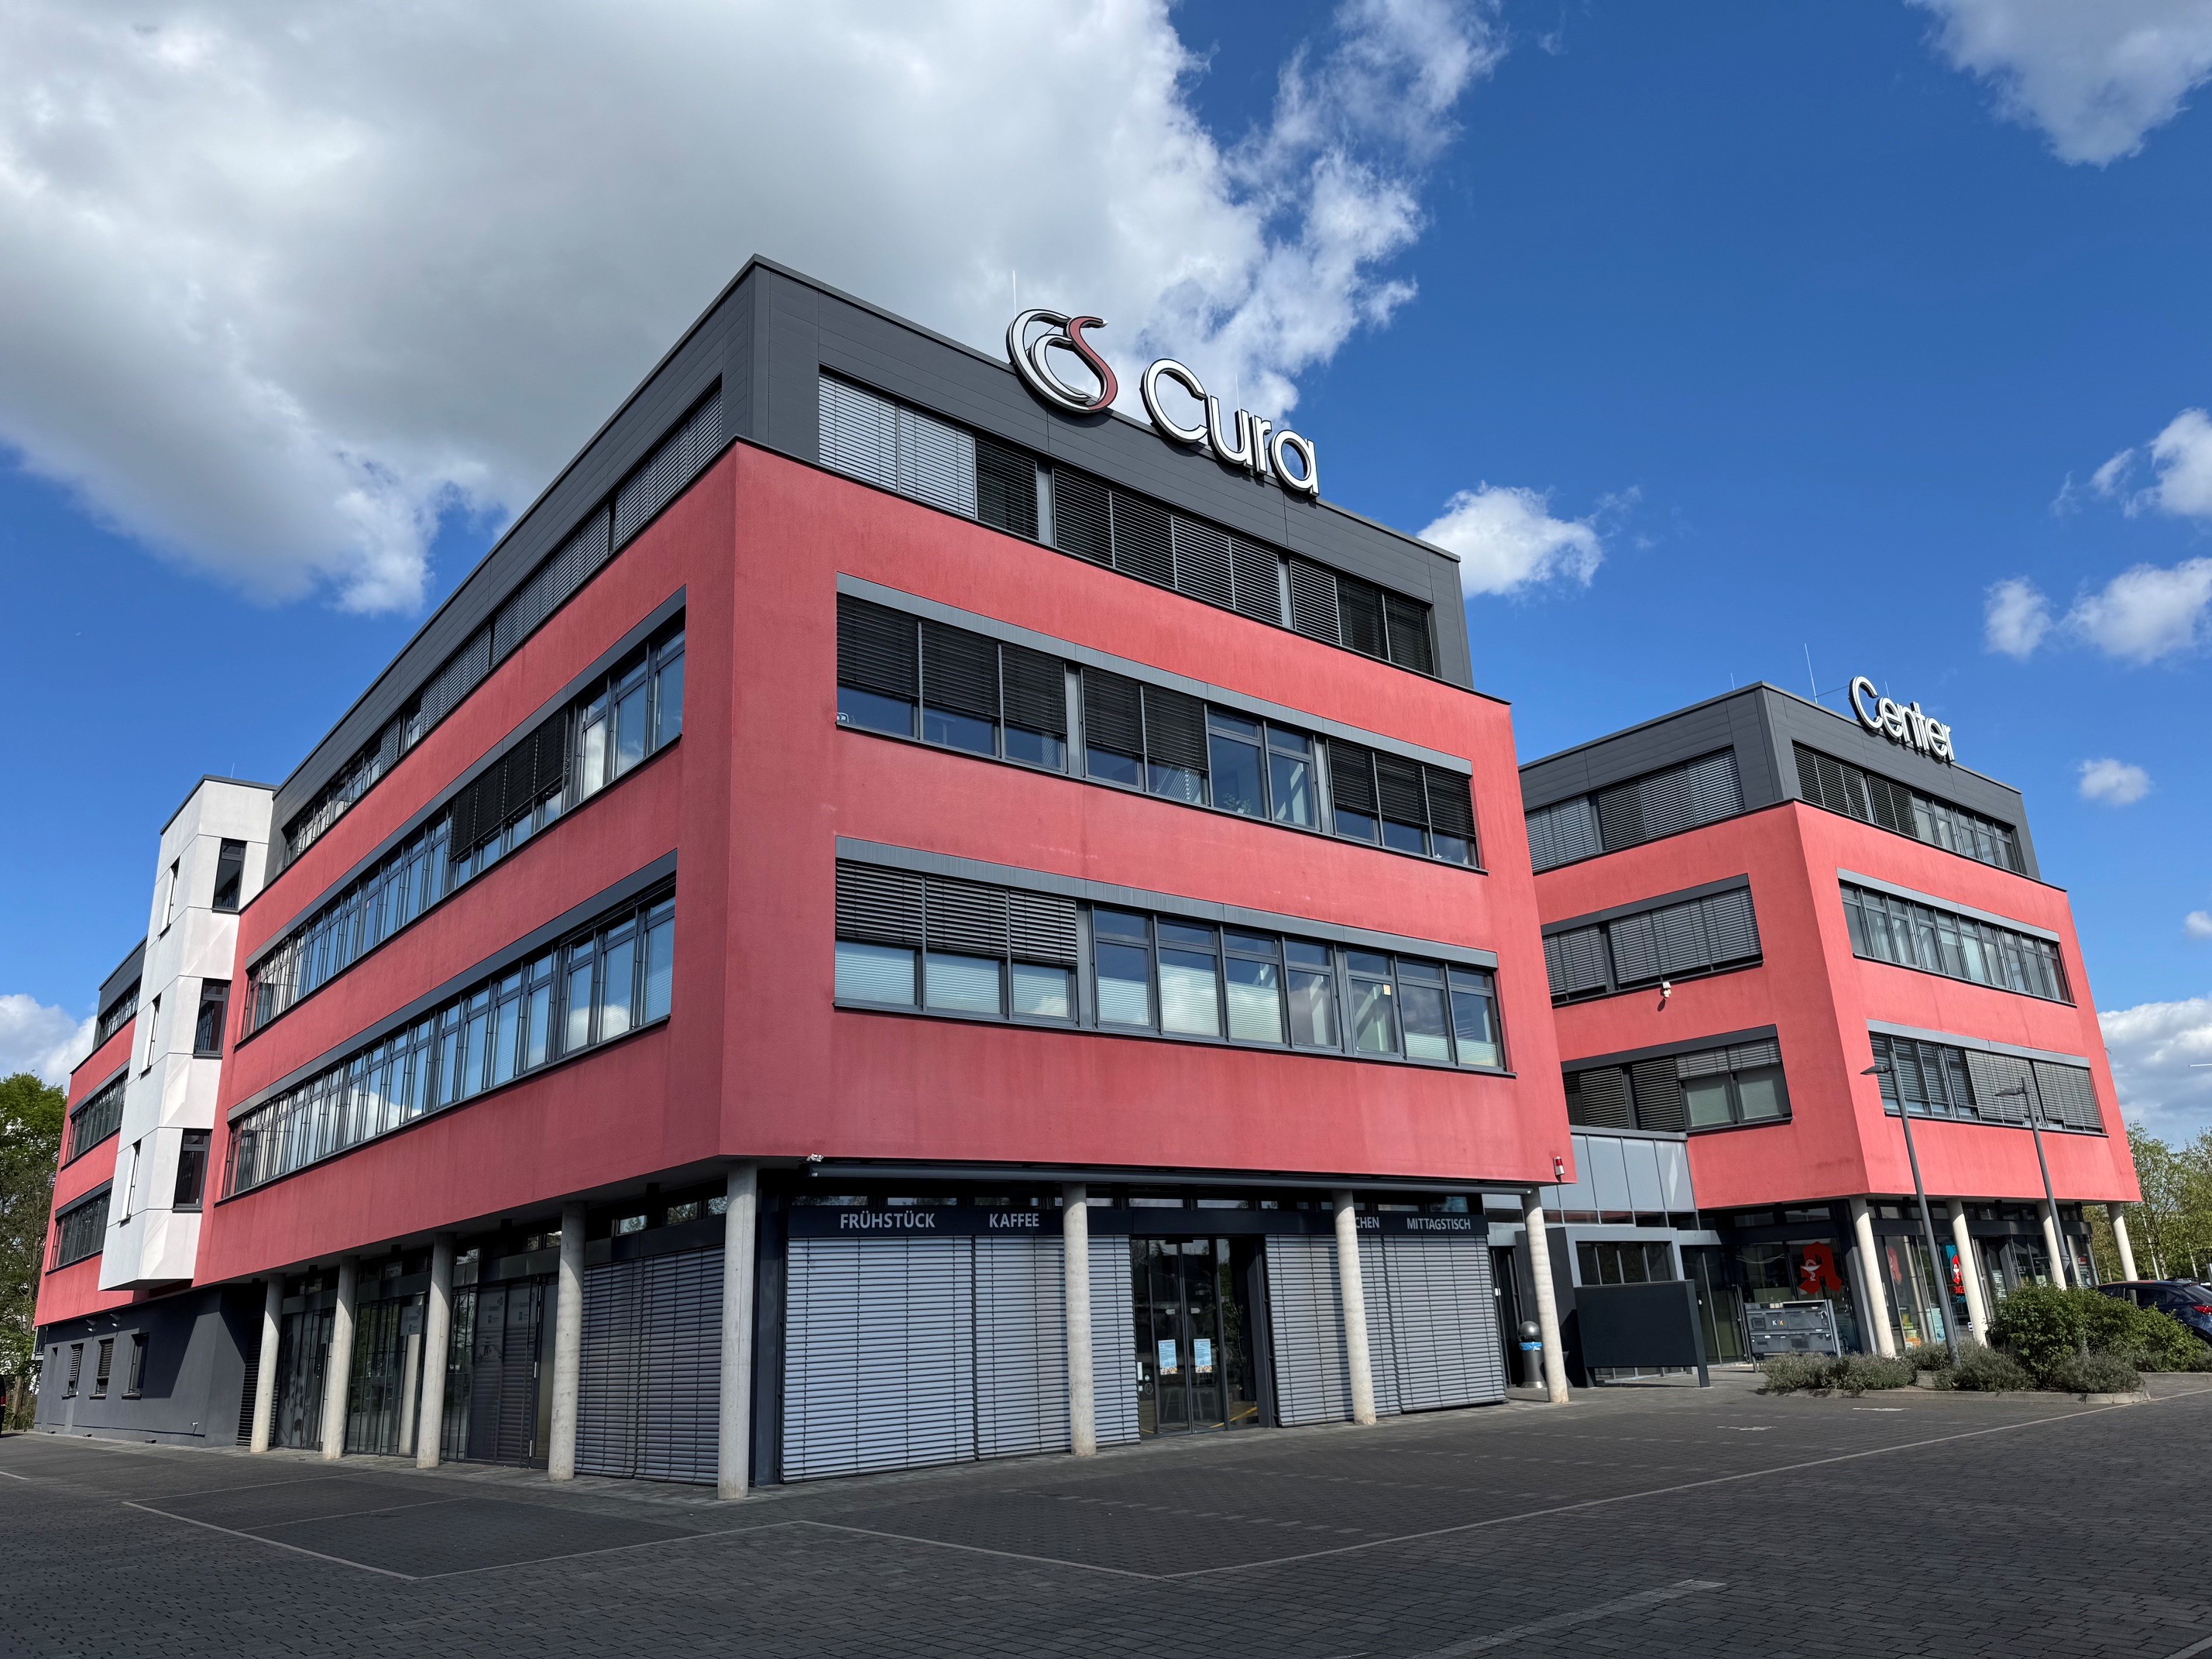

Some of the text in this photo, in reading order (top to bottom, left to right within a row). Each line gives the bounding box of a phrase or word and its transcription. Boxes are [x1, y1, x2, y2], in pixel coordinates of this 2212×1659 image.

[1140, 358, 1320, 497] Cura
[1848, 675, 1956, 762] Center
[840, 1210, 1472, 1230] FRÜHSTÜCK KAFFEE CHEN MITTAGSTISCH
